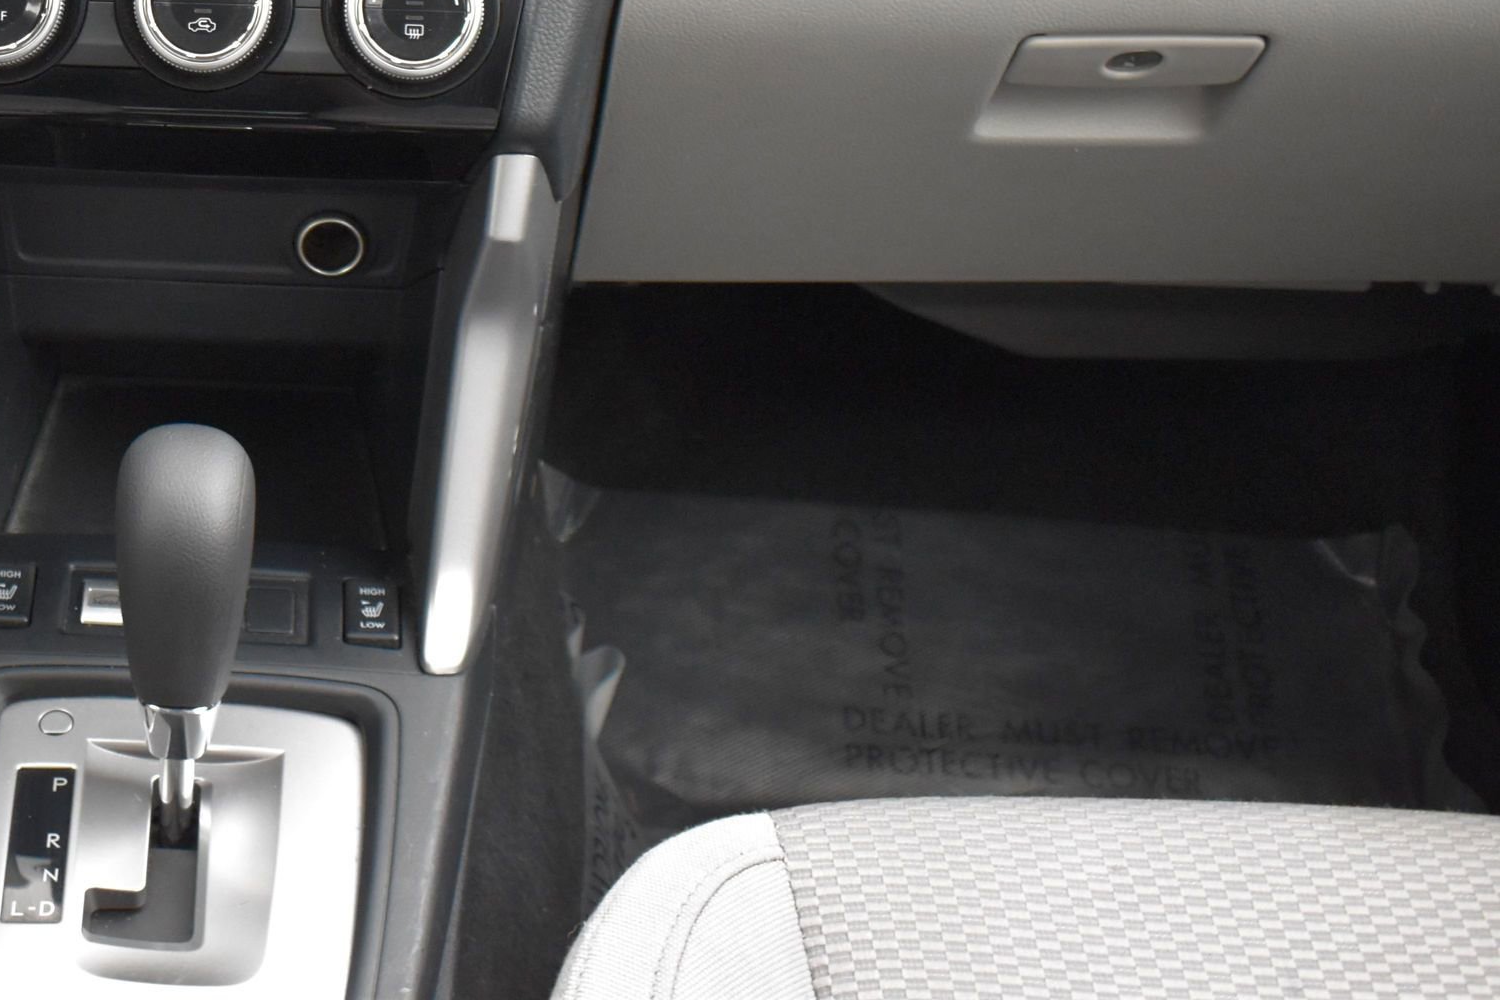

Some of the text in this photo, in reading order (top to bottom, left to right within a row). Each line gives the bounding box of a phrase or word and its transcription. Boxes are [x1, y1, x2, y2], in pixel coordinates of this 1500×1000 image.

[360, 587, 385, 596] HIGH
[360, 620, 385, 630] LOW
[842, 704, 975, 742] DEALER
[844, 743, 1202, 796] PROTECTIVE COVER
[52, 777, 68, 792] P
[46, 833, 61, 848] R
[42, 868, 59, 882] N
